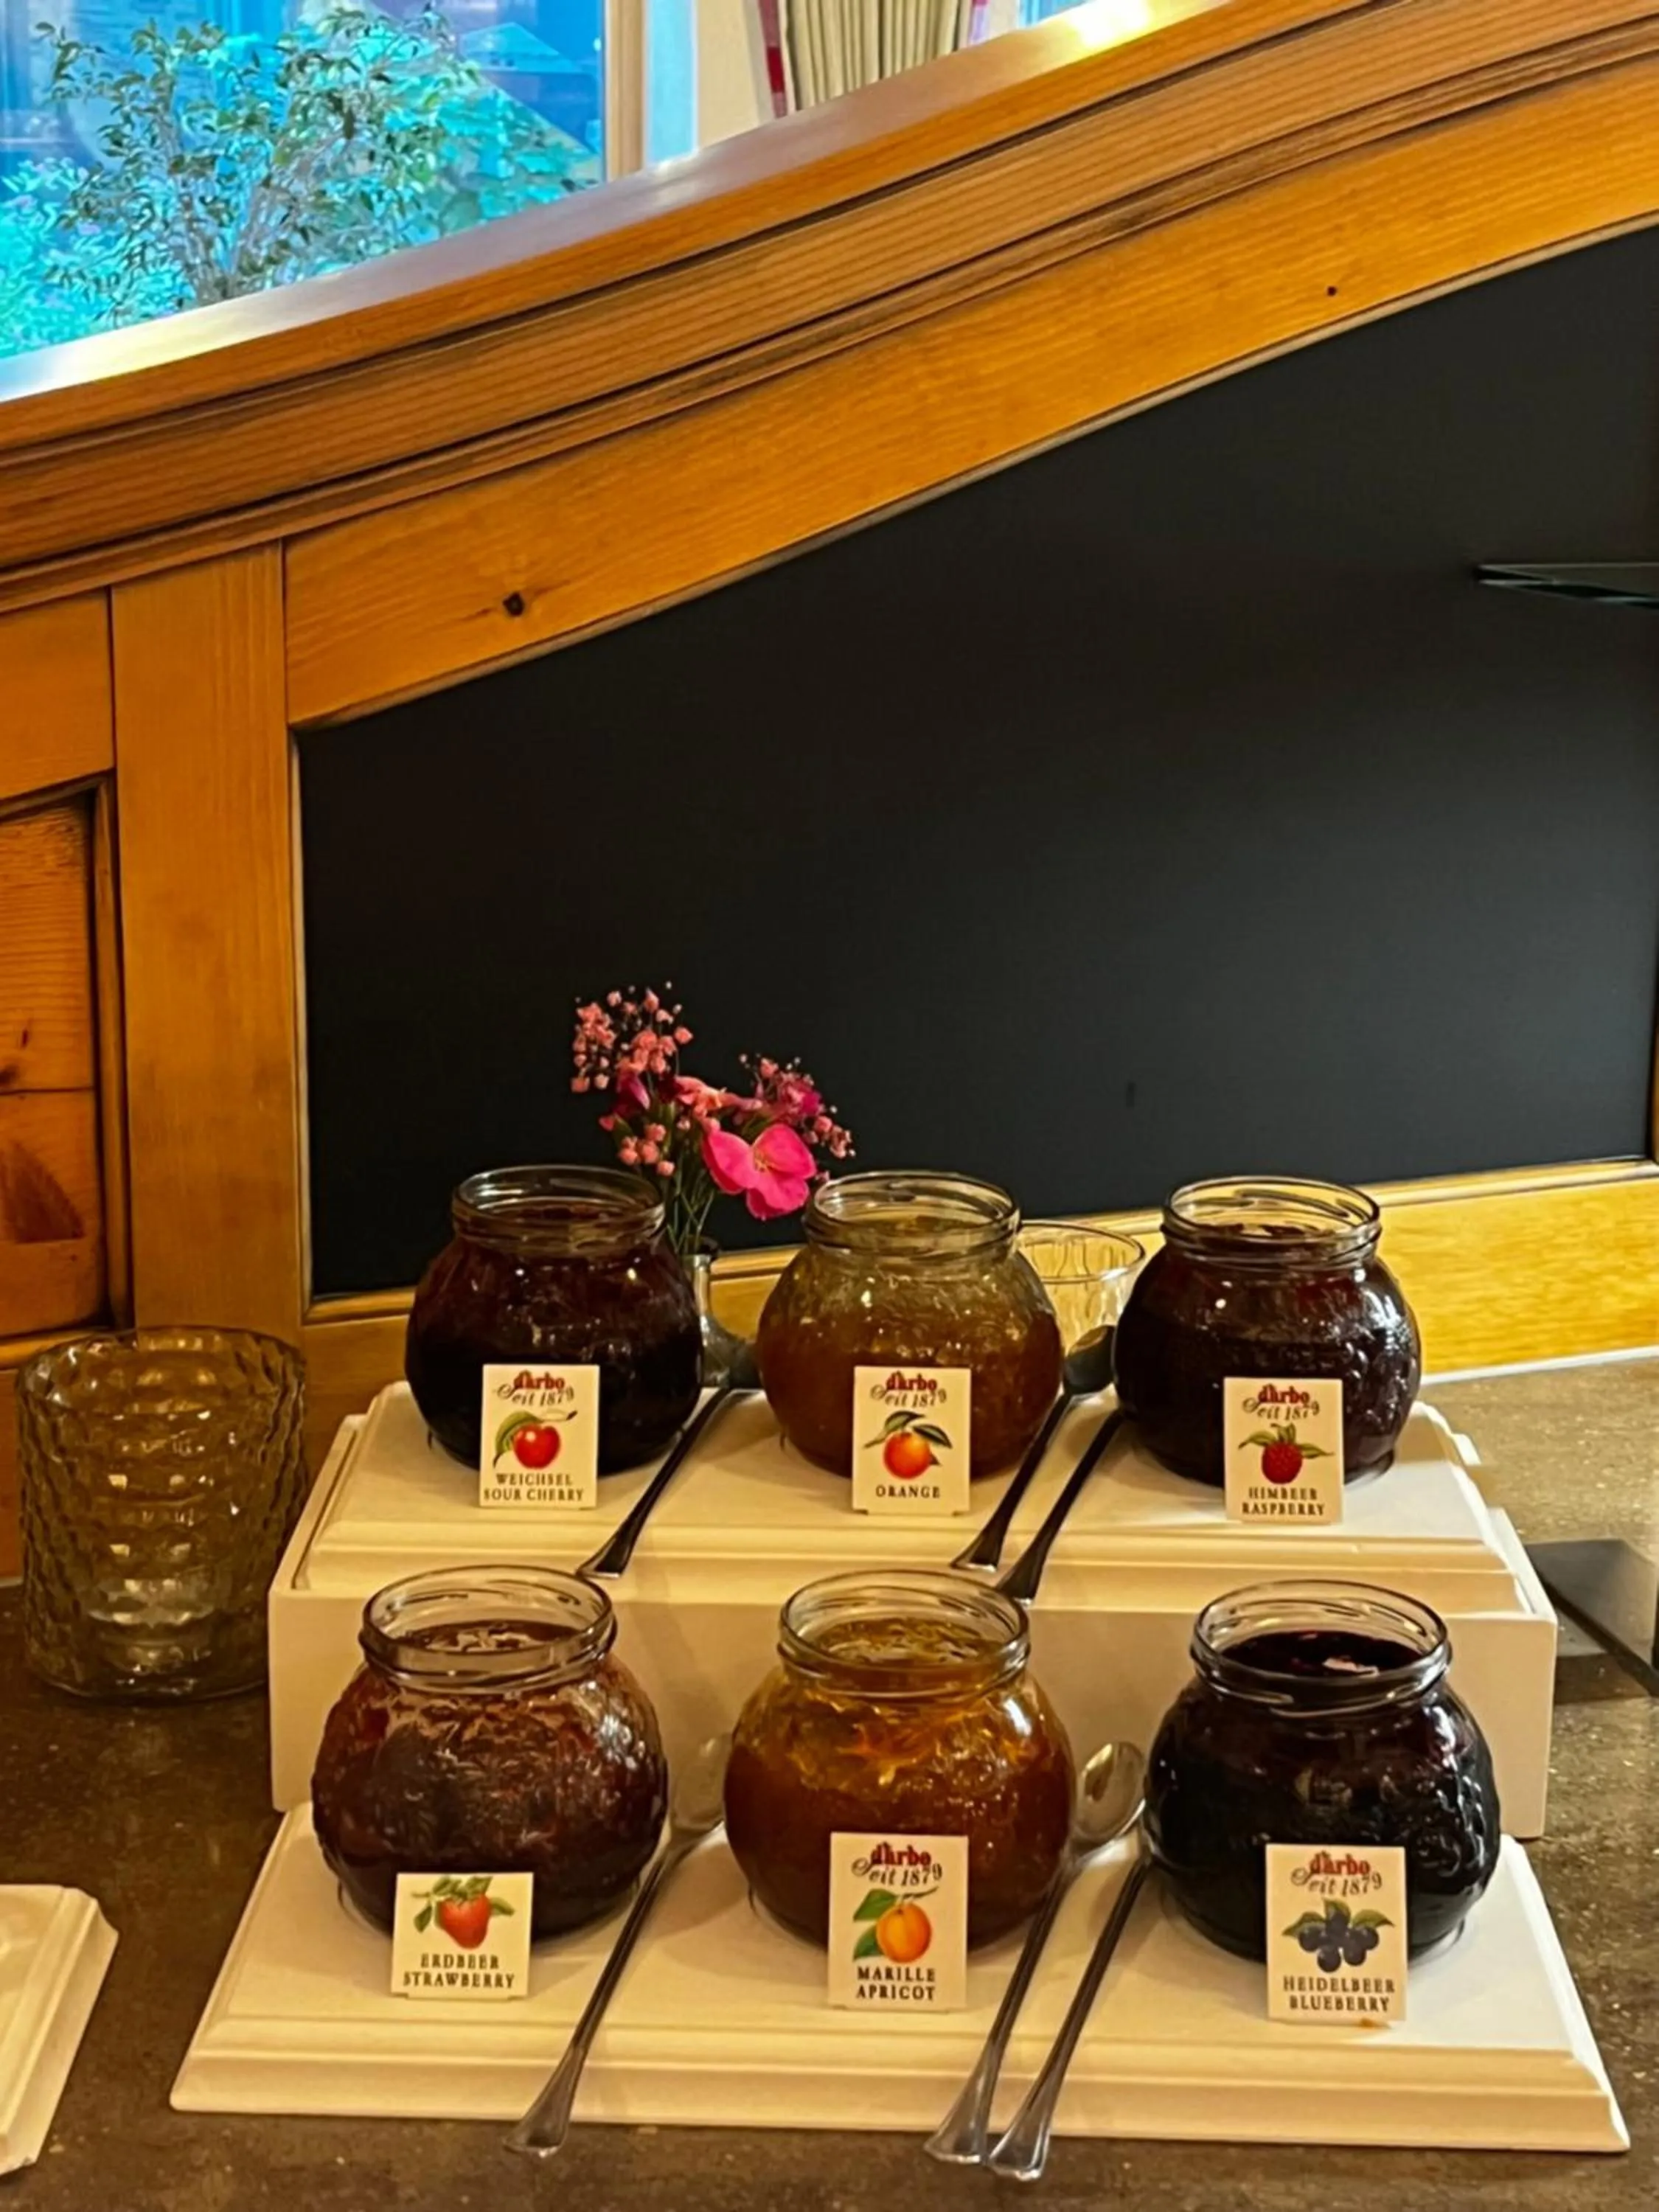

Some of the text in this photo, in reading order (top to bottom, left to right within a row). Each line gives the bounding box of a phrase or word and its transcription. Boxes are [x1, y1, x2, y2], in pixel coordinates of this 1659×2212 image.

[495, 1472, 573, 1486] WEICHSEL
[483, 1487, 584, 1502] SOUR CHERRY
[875, 1484, 941, 1498] ORANGE
[1248, 1486, 1318, 1500] HIMBEER
[1242, 1502, 1325, 1516] RASPBERRY
[420, 1952, 500, 1969] ERDBEER
[403, 1971, 515, 1989] STRAWBERRY
[857, 1965, 936, 1983] MARILLE
[855, 1984, 936, 2001] APRICOT
[1283, 1975, 1395, 1993] HEIDELBEER
[1289, 1995, 1390, 2012] BLUEBERRY
